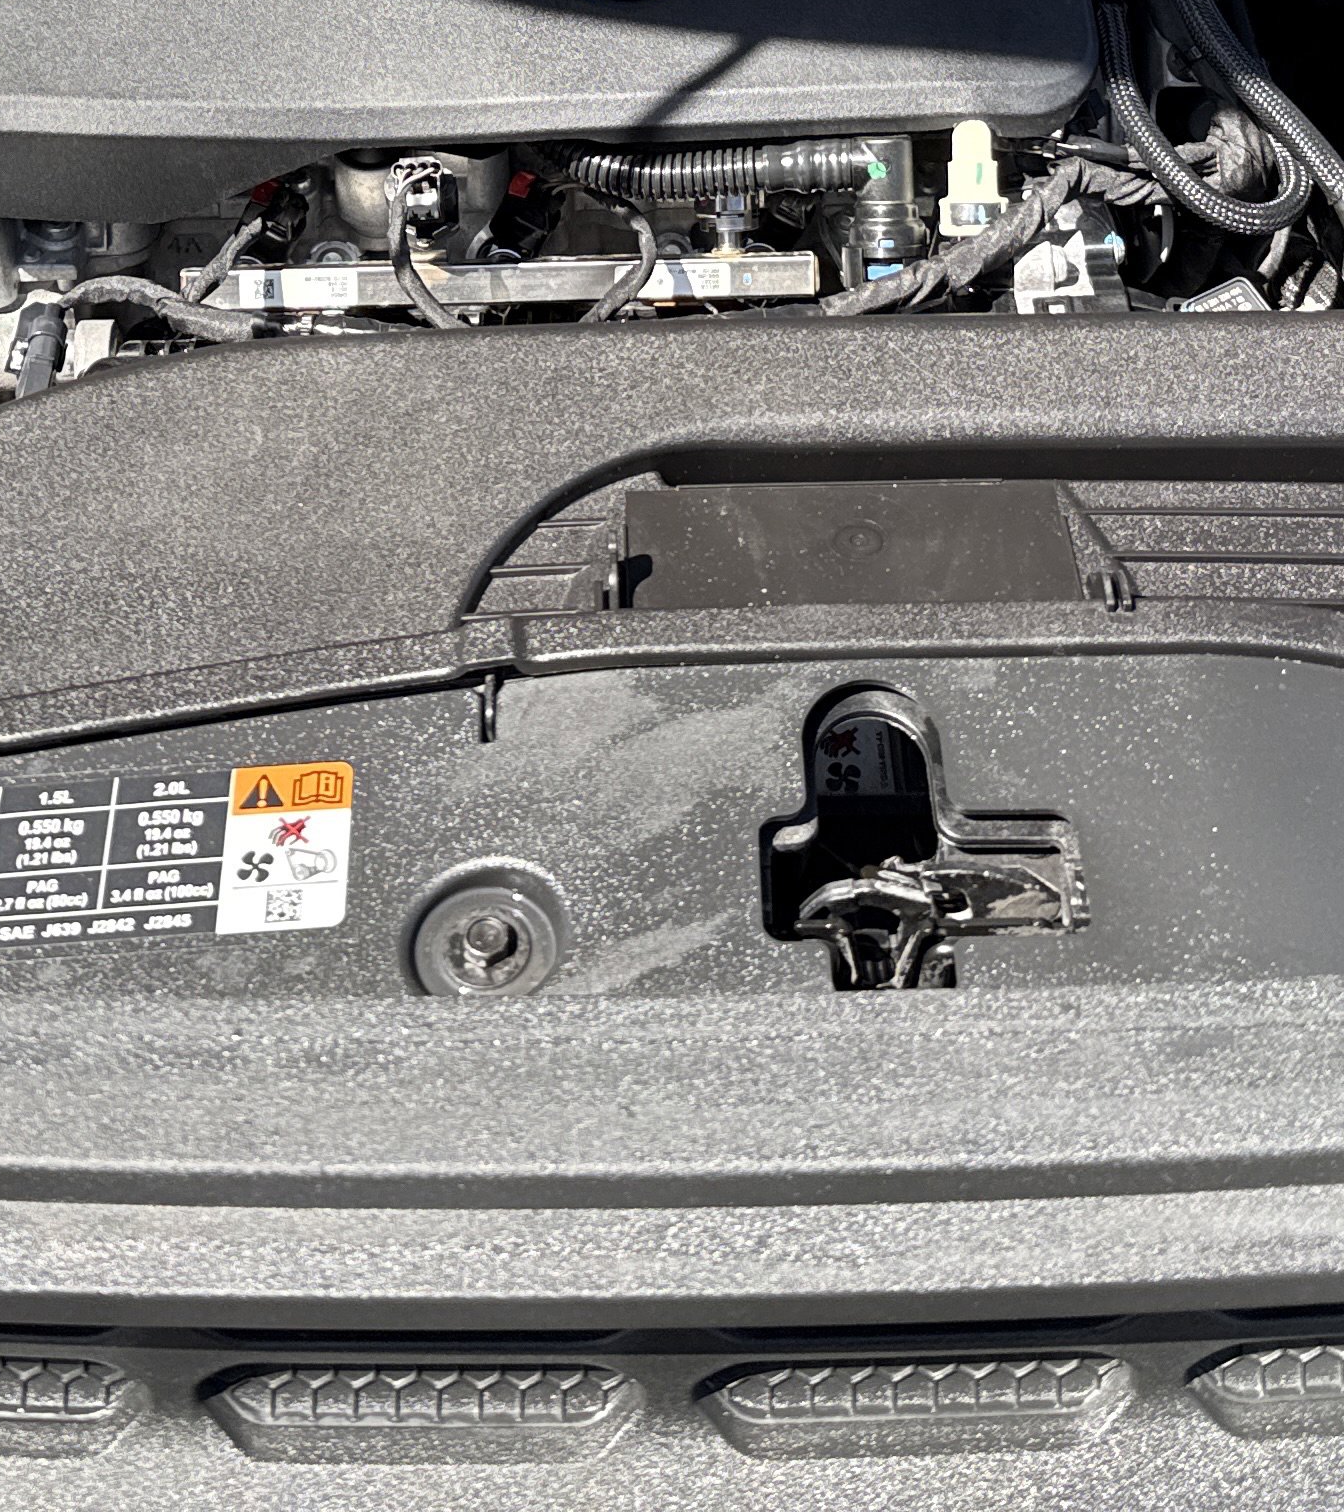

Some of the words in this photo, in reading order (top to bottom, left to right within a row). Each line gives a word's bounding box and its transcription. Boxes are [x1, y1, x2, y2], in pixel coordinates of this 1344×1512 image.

[153, 780, 192, 797] 2.0L
[38, 789, 75, 806] 1.5L
[137, 808, 181, 827] 0.550
[182, 808, 204, 827] kg
[17, 818, 62, 836] 0.550
[63, 817, 85, 836] kg
[147, 868, 181, 885] PAG
[25, 878, 60, 894] PAG
[109, 888, 132, 903] 3.4
